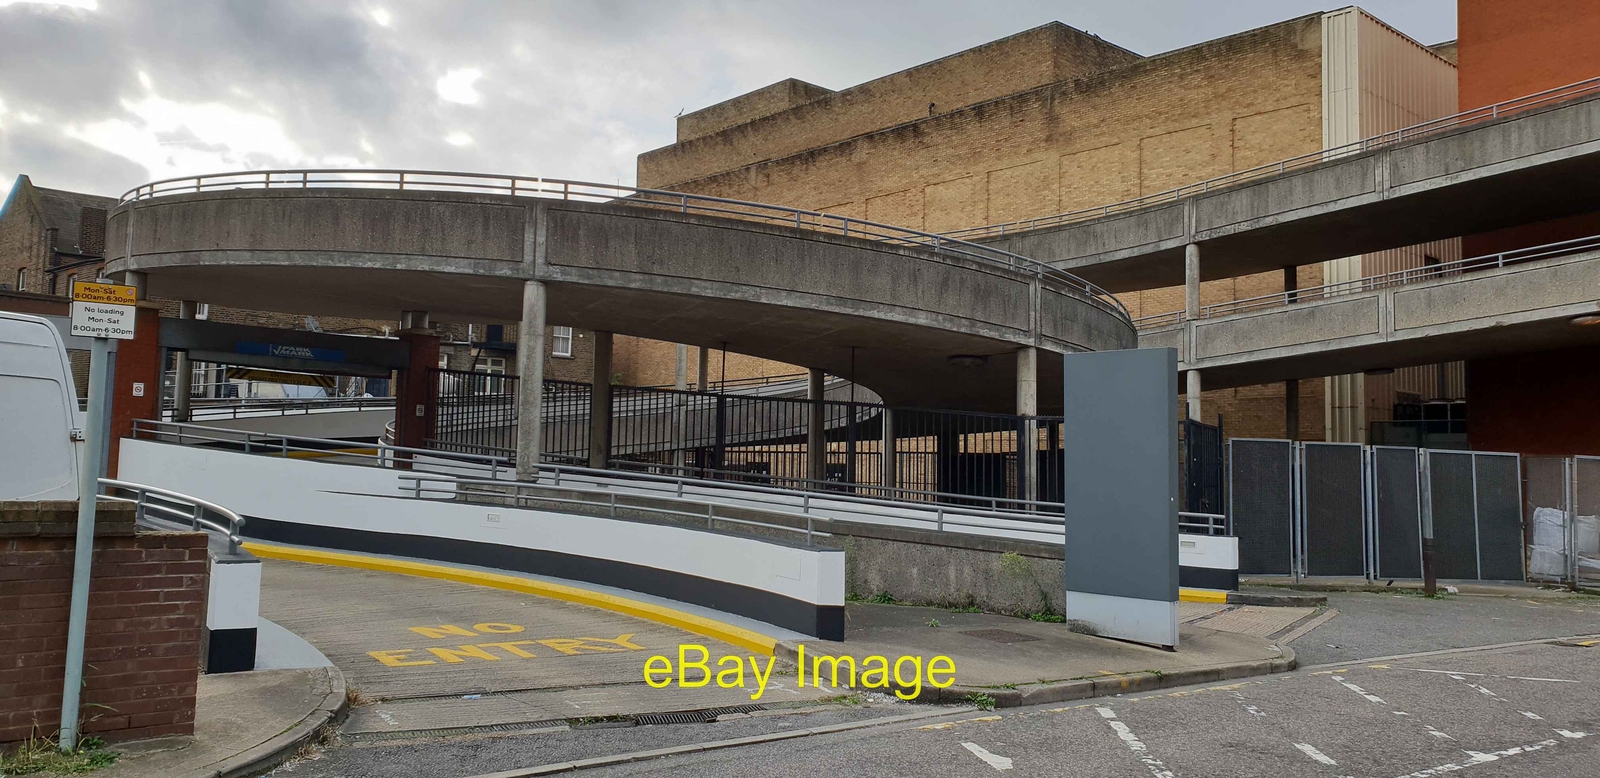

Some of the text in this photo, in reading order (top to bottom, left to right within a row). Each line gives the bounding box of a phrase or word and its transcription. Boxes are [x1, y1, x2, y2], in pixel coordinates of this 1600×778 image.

[97, 307, 125, 316] loading
[408, 622, 526, 639] NO
[366, 633, 646, 667] ENTRY
